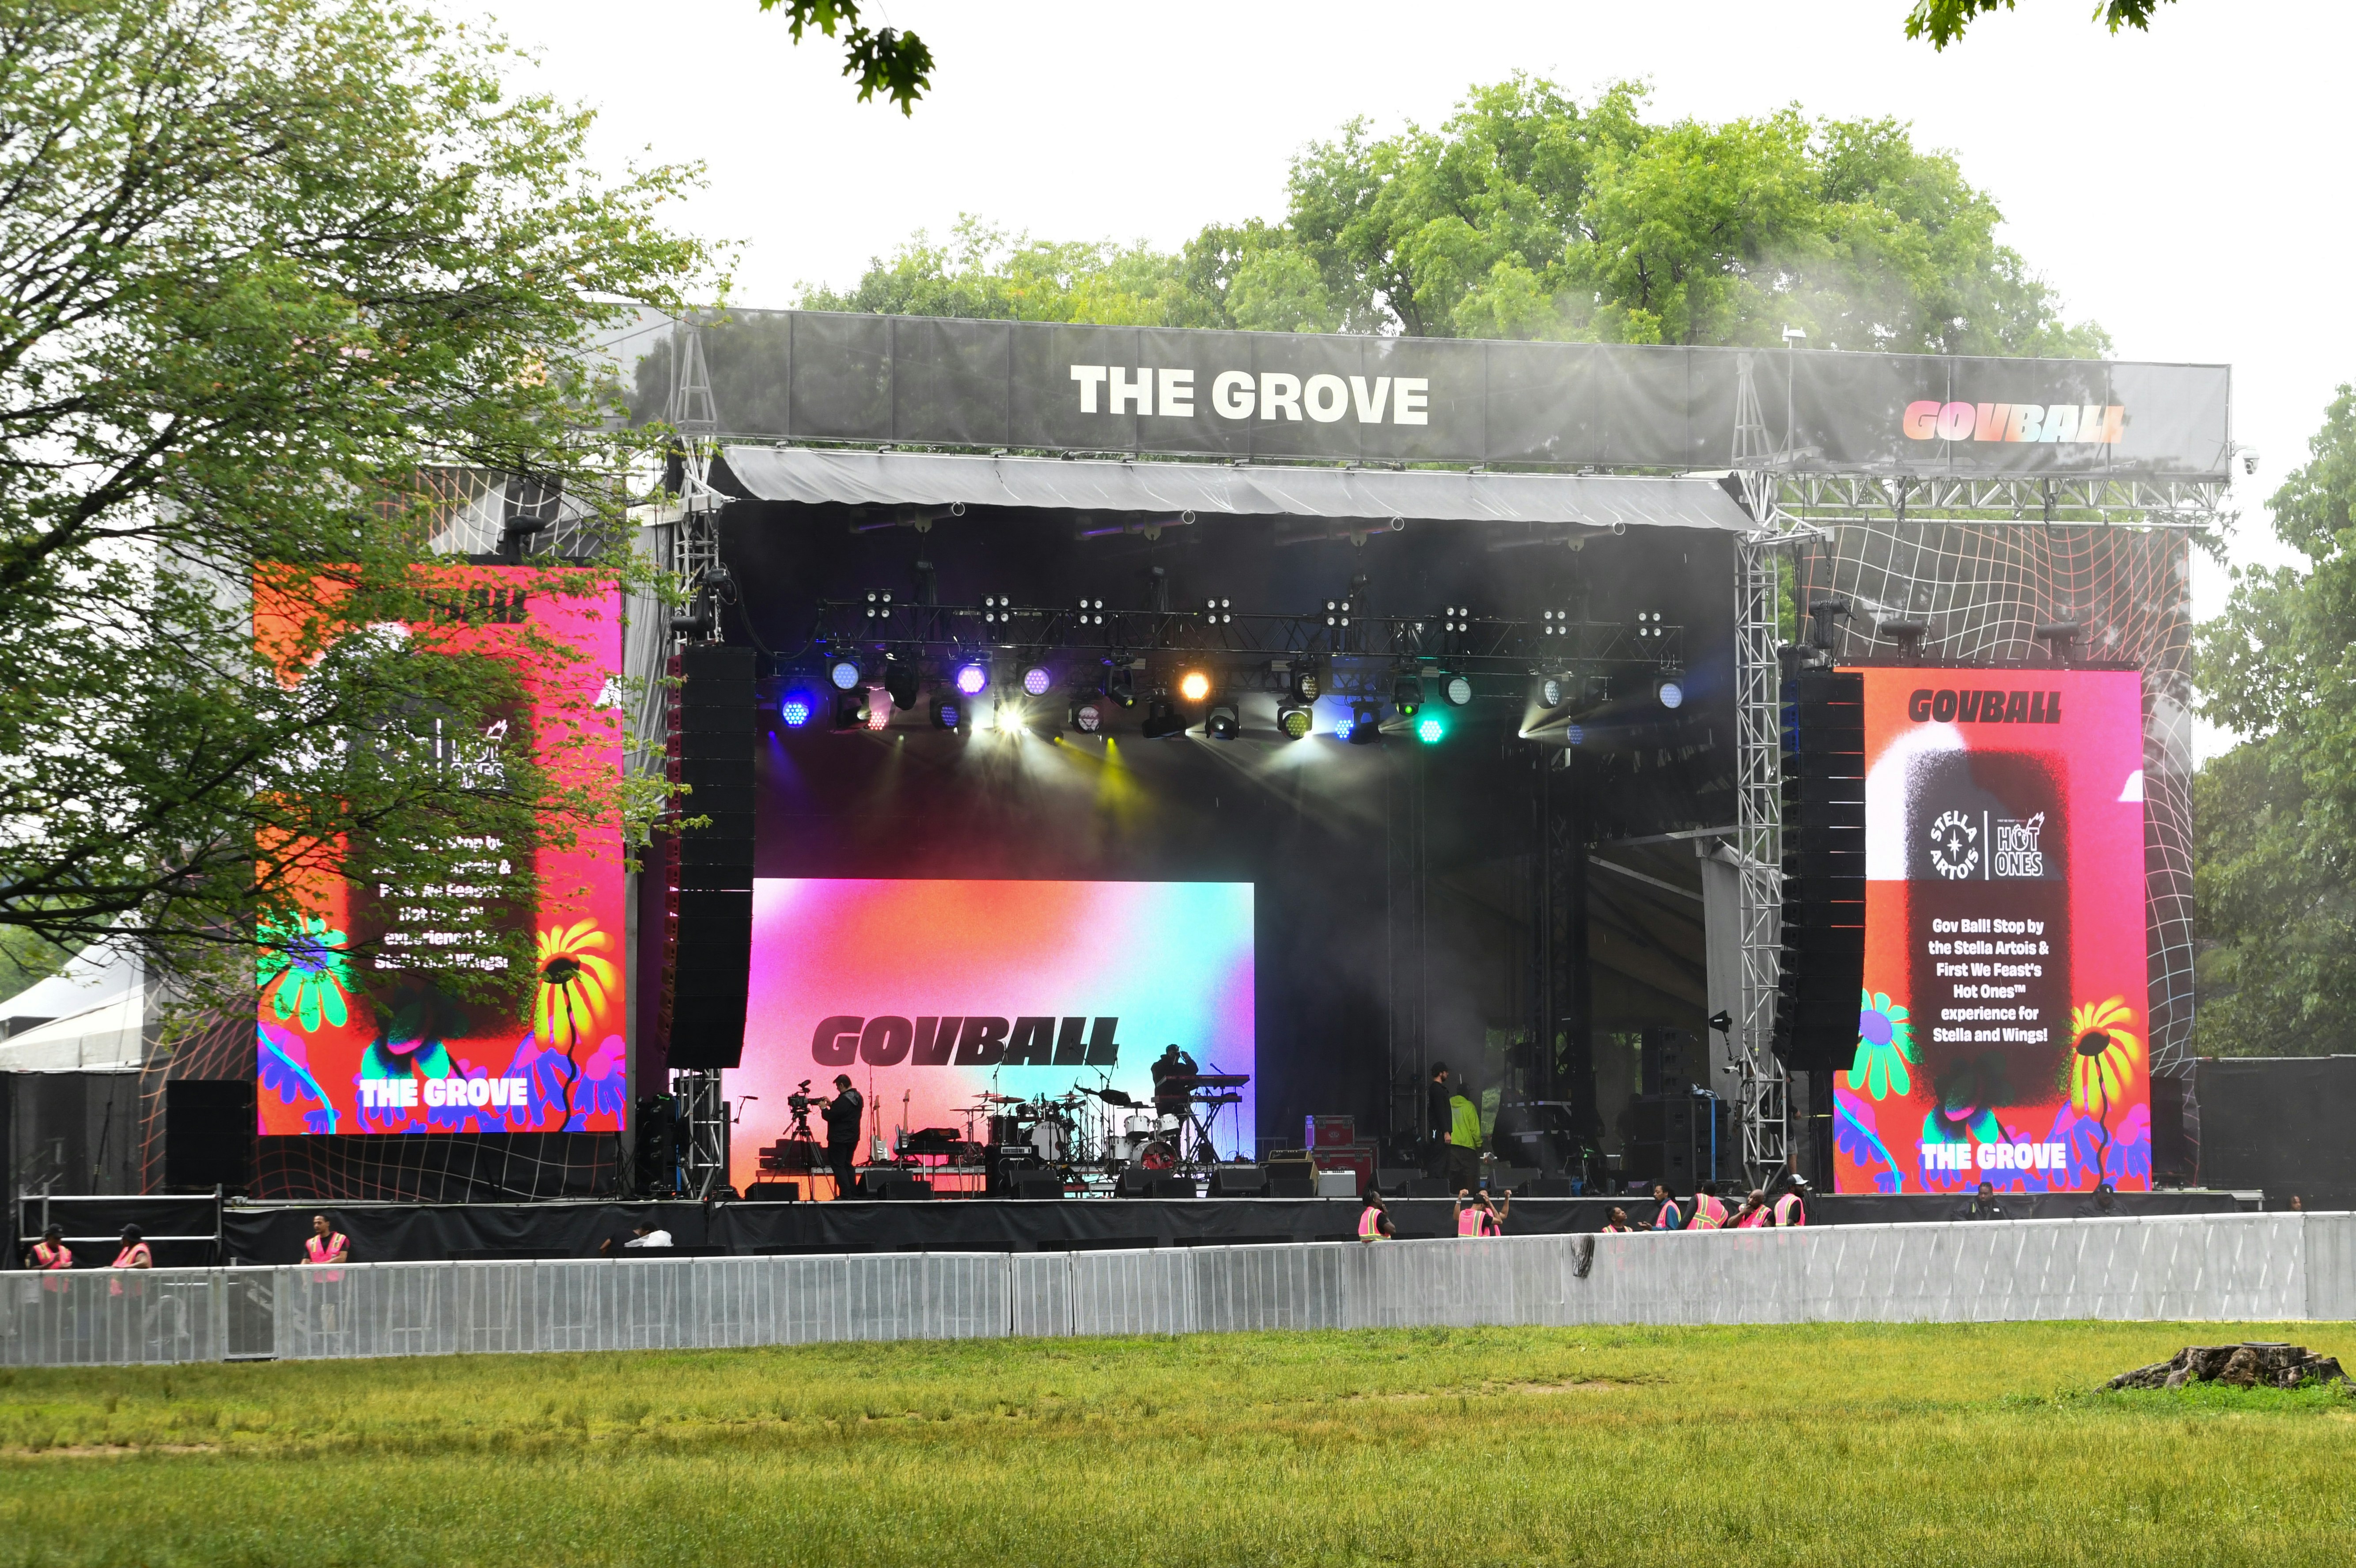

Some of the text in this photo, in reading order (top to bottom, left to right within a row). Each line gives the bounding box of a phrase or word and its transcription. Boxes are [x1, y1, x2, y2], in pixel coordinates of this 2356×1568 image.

[1071, 365, 1428, 425] THE GROVE
[1903, 401, 2125, 444] GOVBALL
[1909, 689, 2062, 724] GOVBALL
[1931, 810, 1977, 843] STELLA
[1997, 826, 2040, 851] HOT
[499, 860, 511, 874] &
[1995, 852, 2043, 877] ONES
[1933, 919, 2044, 935] Gov Ball! Stop by
[1928, 941, 2049, 955] the Stella Artois &
[1937, 963, 1968, 976] First
[1971, 963, 1991, 976] We
[1954, 985, 1978, 998] Hot
[1941, 1006, 2038, 1022] experience for
[812, 1015, 1120, 1066] GOVBALL
[1933, 1028, 2047, 1043] Stella and Wings!
[360, 1077, 527, 1107] THE GROVE
[1921, 1143, 2066, 1169] THE GROVE
